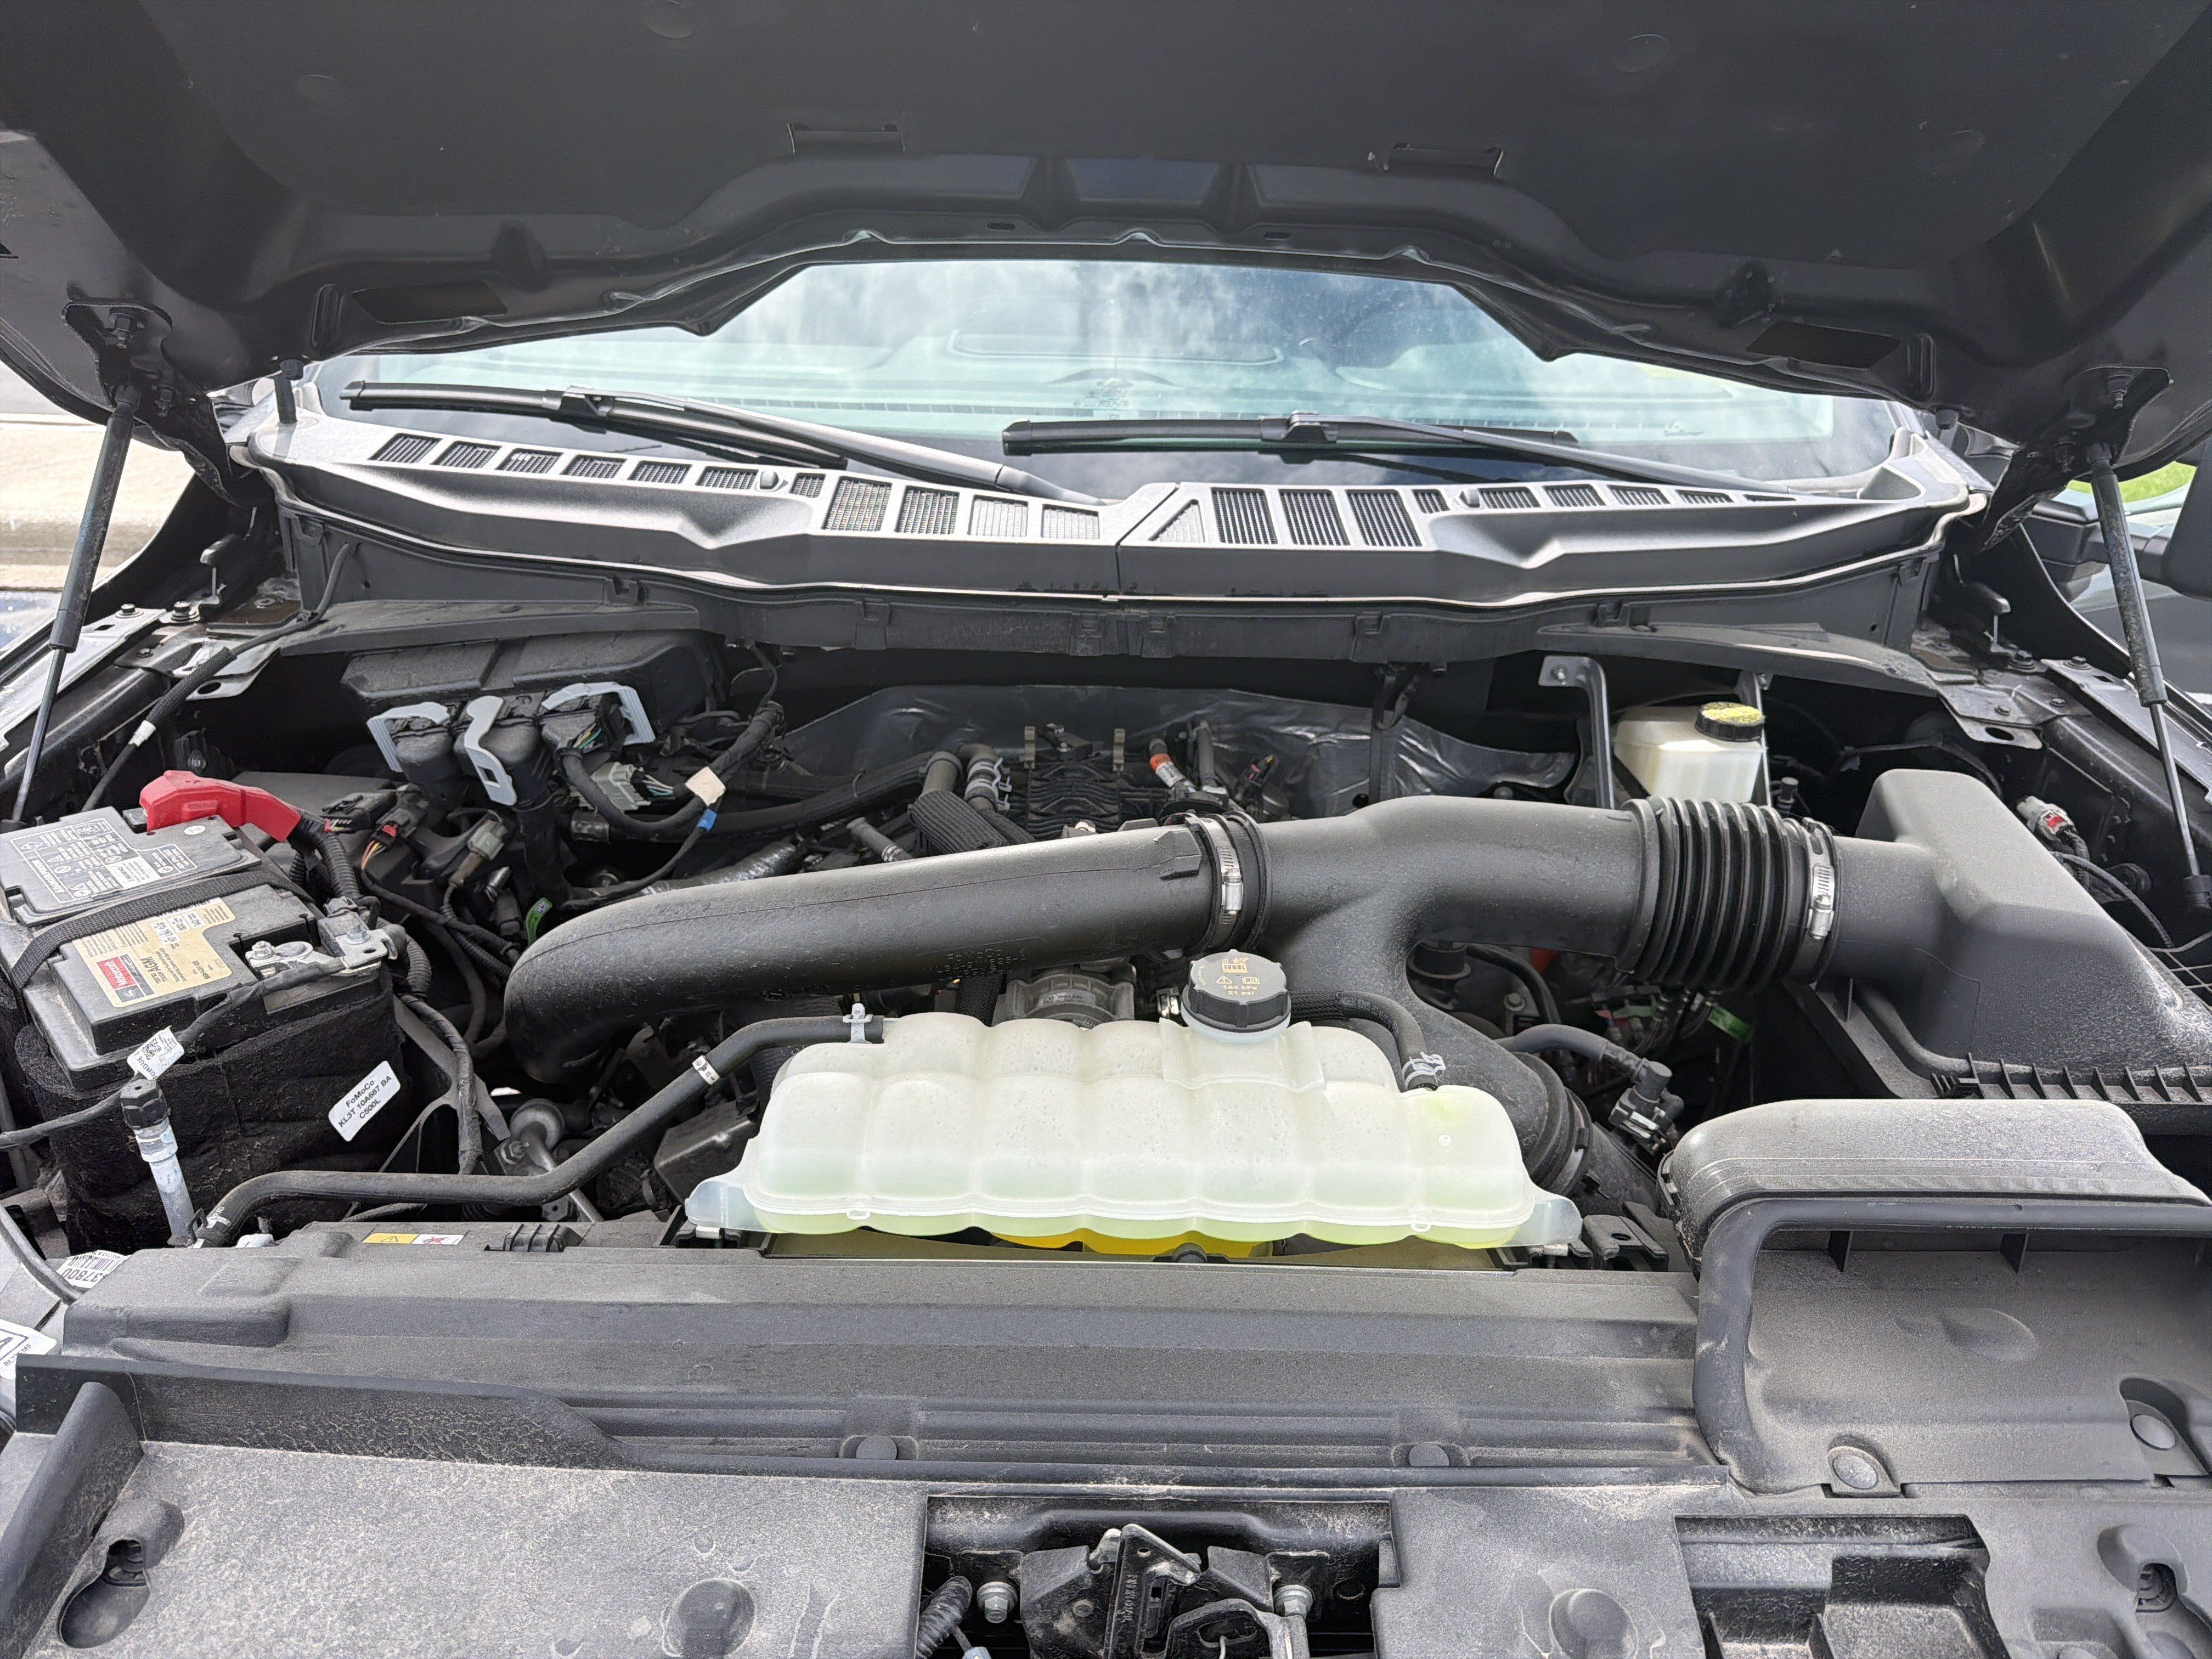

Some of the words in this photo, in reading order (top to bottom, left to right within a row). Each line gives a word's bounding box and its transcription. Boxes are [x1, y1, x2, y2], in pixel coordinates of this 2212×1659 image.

[104, 960, 128, 986] Motorcraft
[139, 956, 161, 972] AGM
[338, 1108, 356, 1127] KL3T
[357, 1085, 380, 1109] 10A687
[380, 1075, 392, 1087] BA
[346, 1080, 375, 1108] FoMoCo
[359, 1099, 381, 1119] C500L
